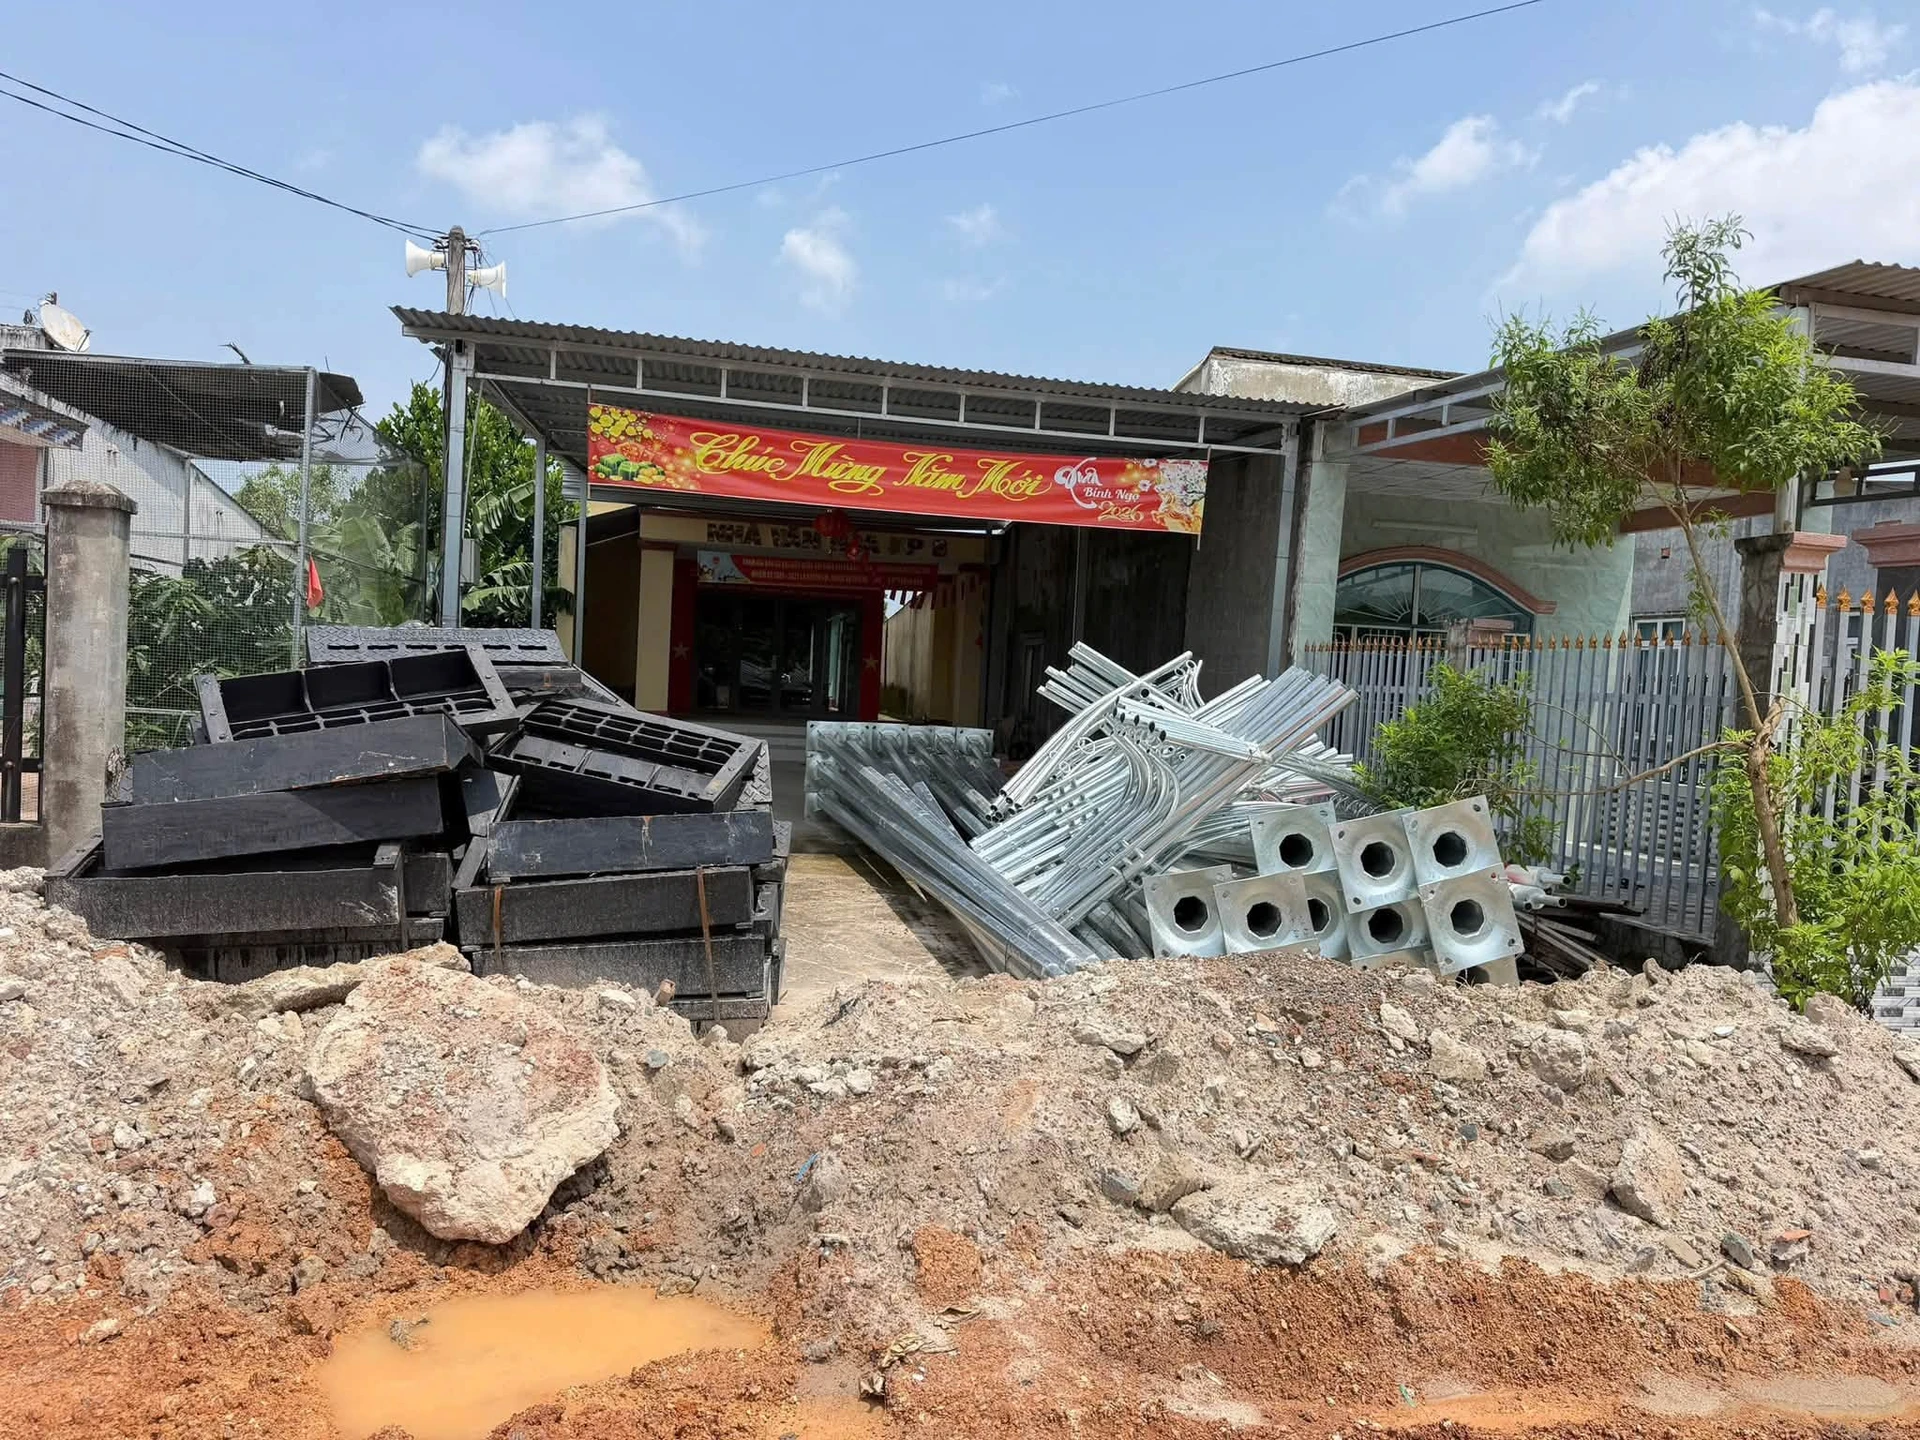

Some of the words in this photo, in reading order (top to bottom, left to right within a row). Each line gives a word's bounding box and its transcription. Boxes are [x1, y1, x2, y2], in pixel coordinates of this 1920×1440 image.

[690, 432, 786, 475] Chúc
[770, 441, 887, 496] Mừng
[893, 452, 966, 490] Năm
[956, 458, 1052, 501] Mới
[1083, 487, 1112, 499] Bính
[1098, 500, 1144, 522] 2026
